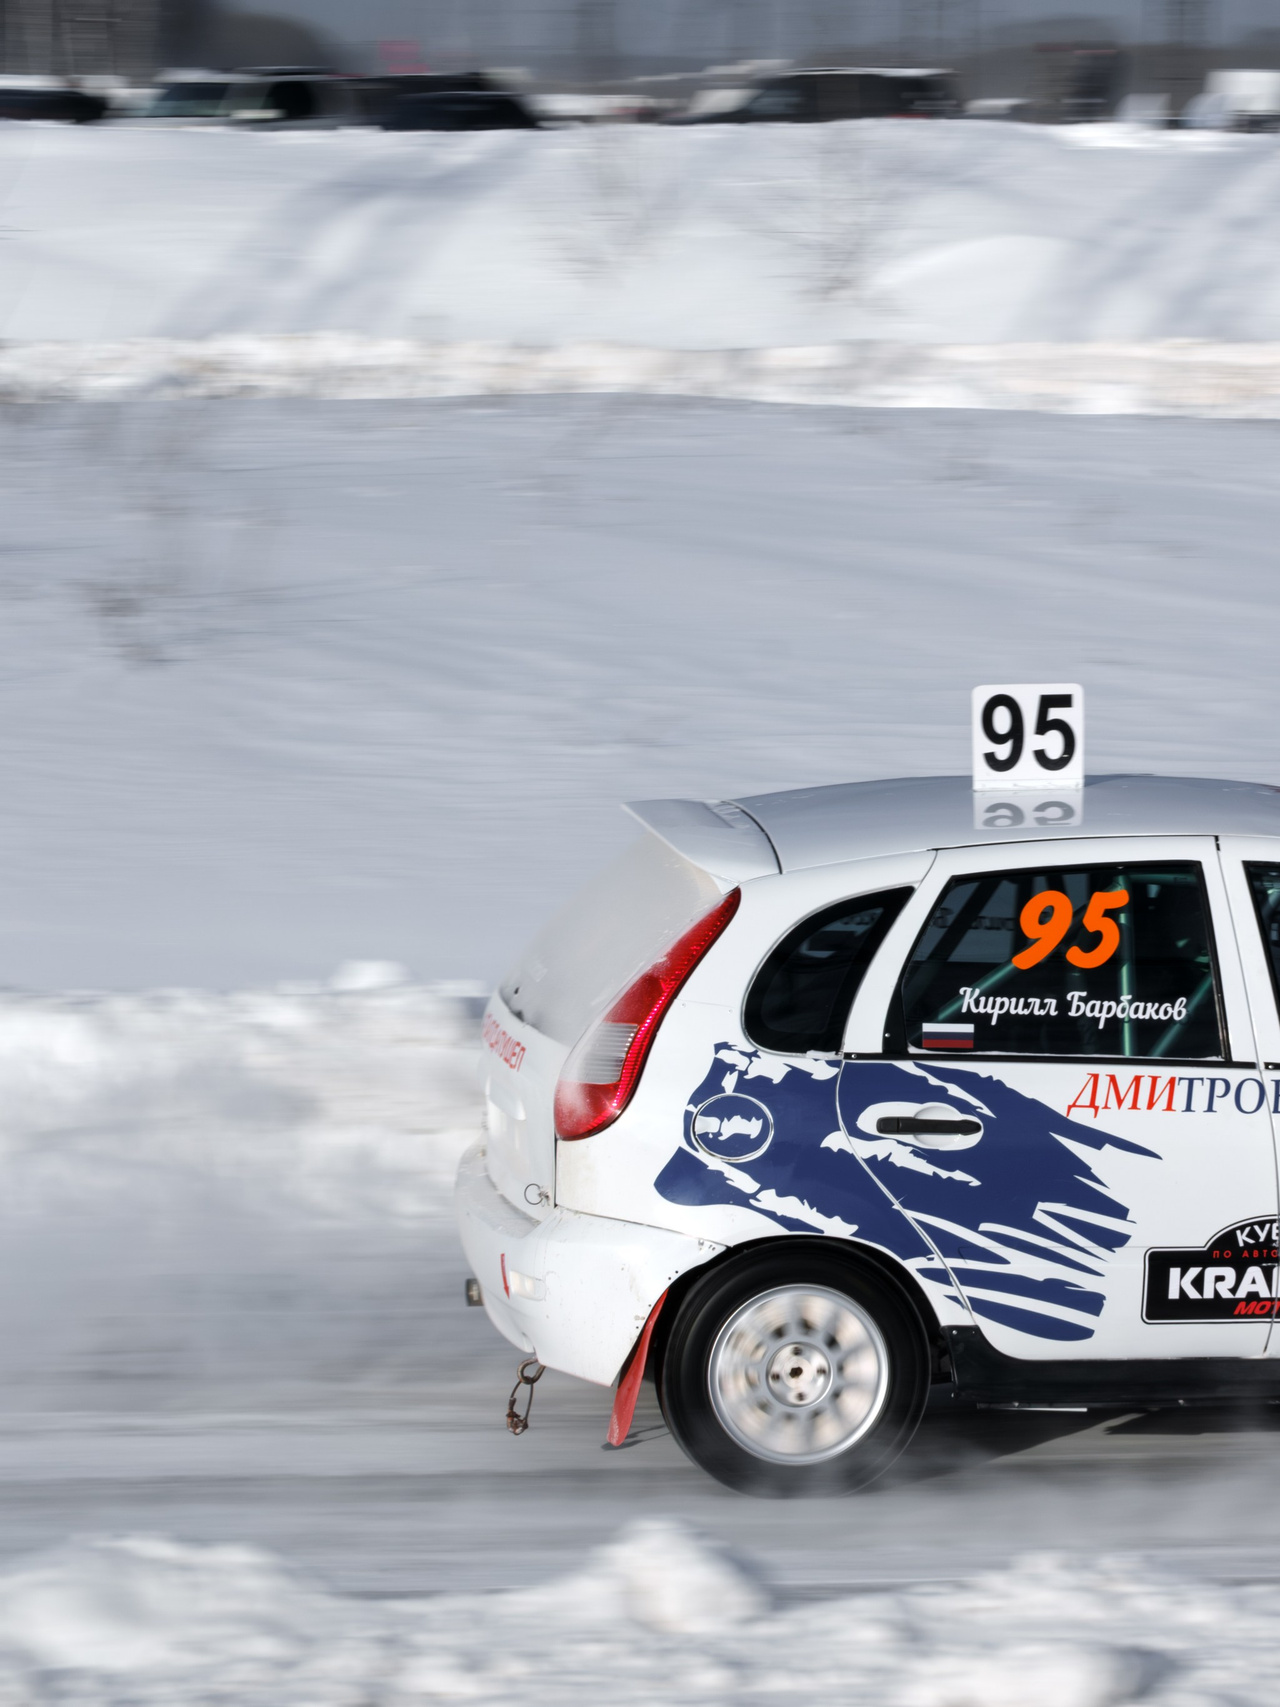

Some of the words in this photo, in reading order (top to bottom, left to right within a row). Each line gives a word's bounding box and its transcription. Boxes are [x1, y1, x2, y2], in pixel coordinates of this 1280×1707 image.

[981, 693, 1076, 772] 95
[1012, 889, 1129, 970] 95
[959, 987, 1058, 1026] Кирилл
[1067, 991, 1187, 1030] Барбаков
[1213, 1250, 1232, 1259] ПО
